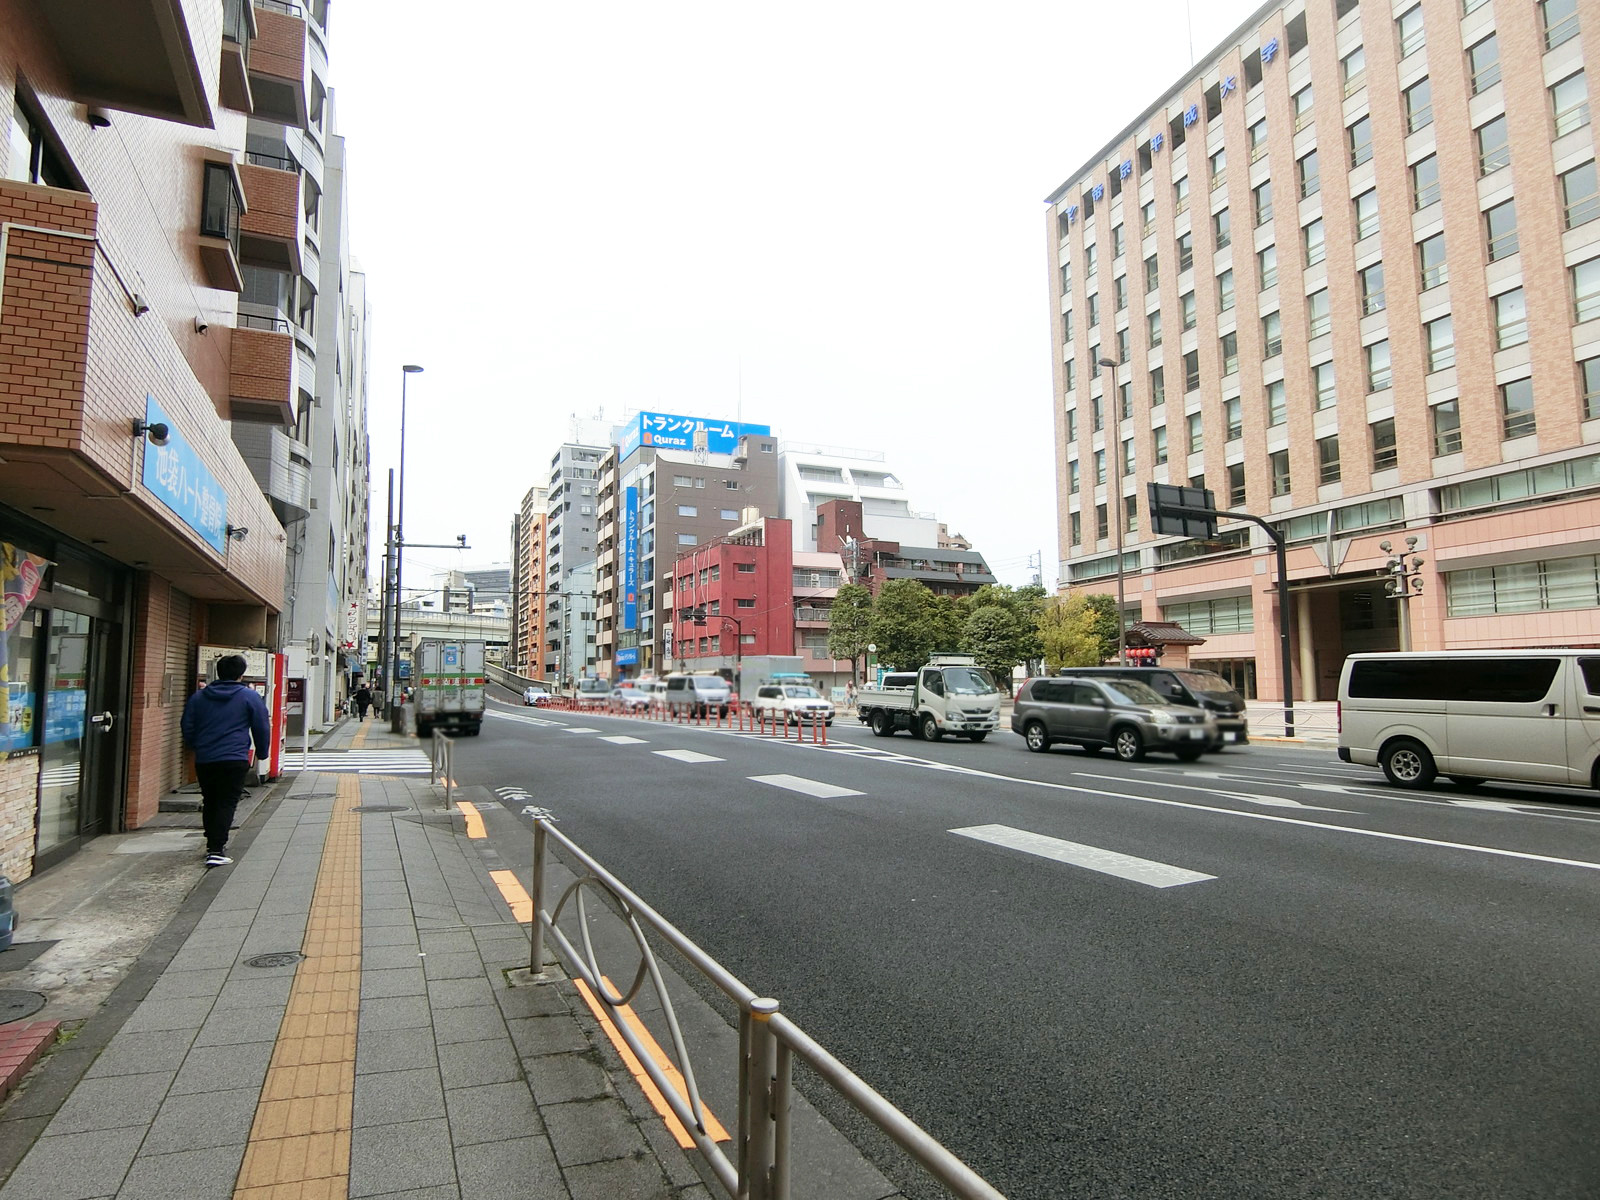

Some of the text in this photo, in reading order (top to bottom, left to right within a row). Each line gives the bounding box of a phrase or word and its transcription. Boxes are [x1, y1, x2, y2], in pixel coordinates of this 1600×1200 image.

[1091, 37, 1279, 202] 帝京平成大学
[643, 414, 735, 439] トランクルーム
[653, 434, 687, 446] Quraz
